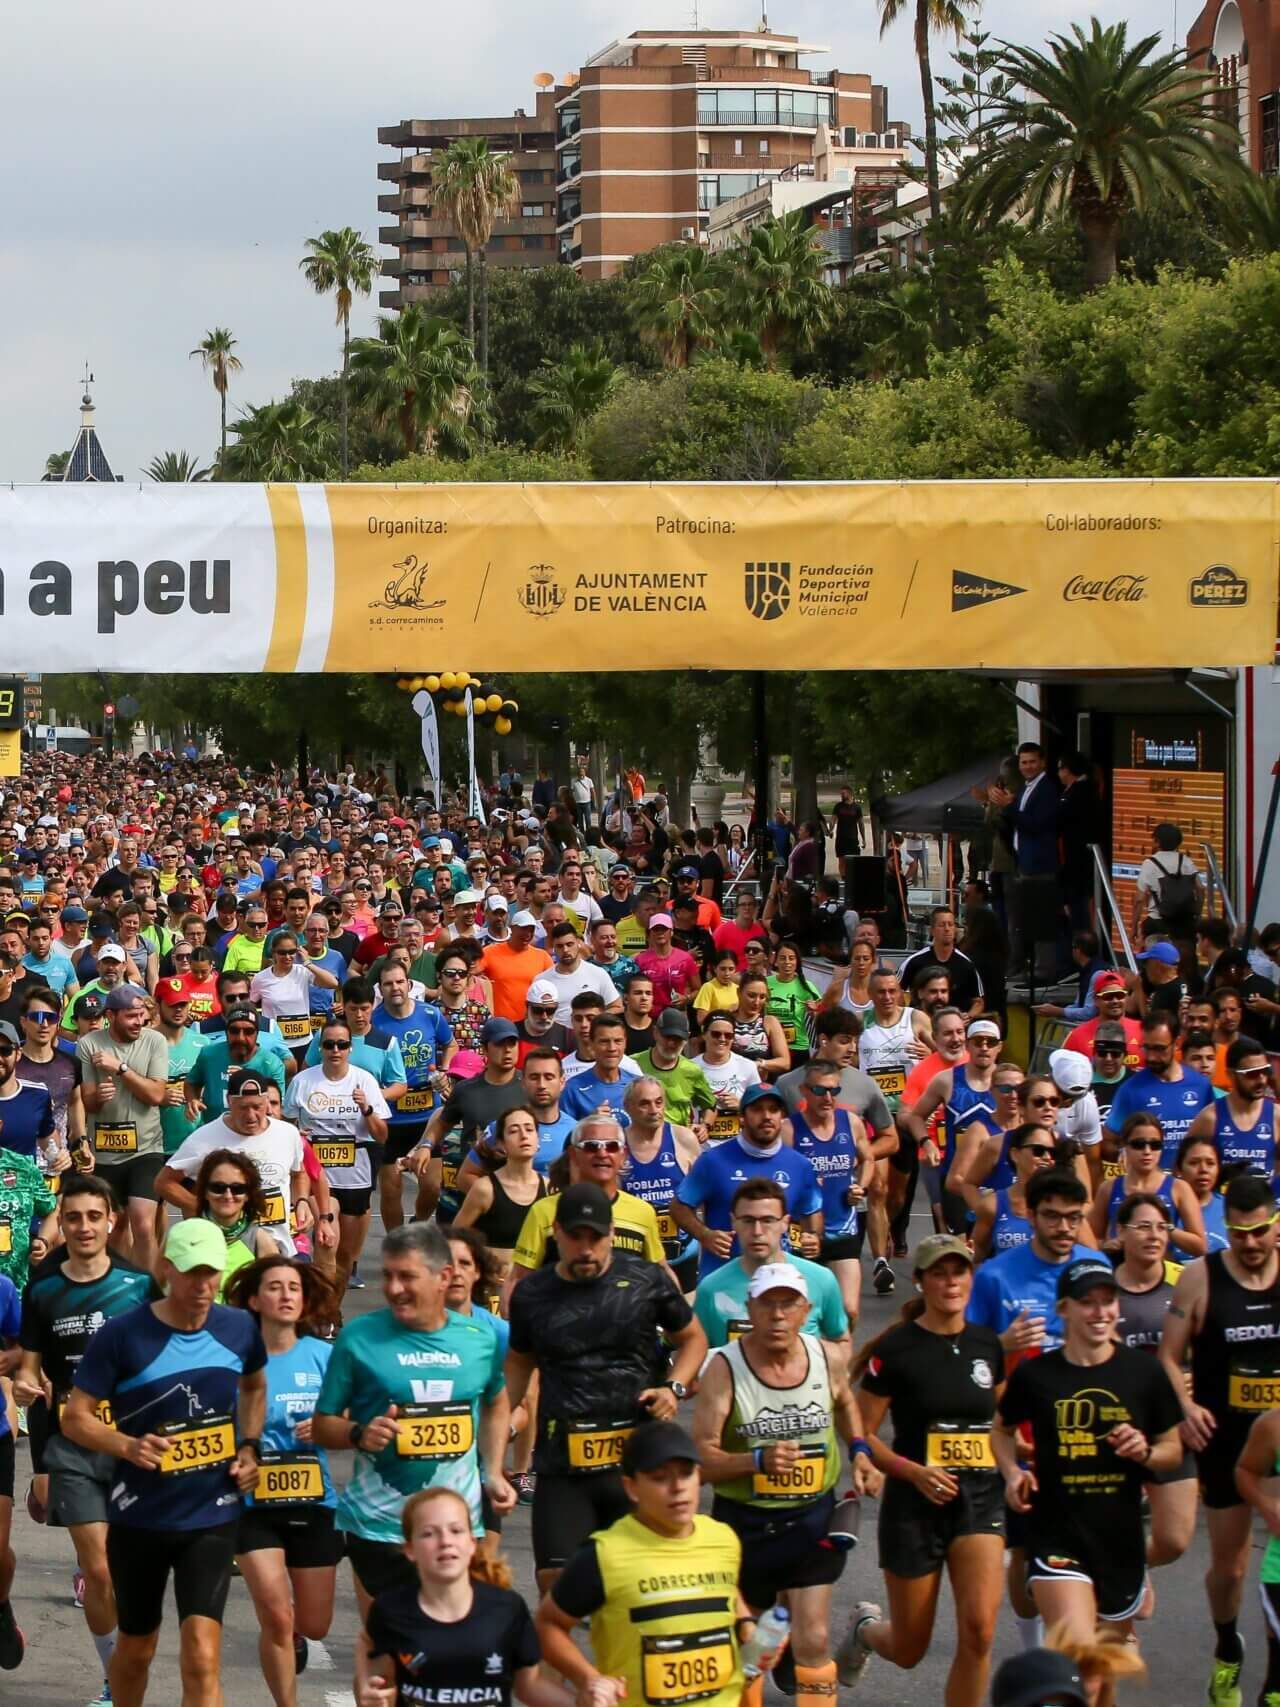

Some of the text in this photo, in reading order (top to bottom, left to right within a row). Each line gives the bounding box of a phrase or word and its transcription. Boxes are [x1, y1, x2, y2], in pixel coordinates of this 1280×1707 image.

[367, 515, 449, 535] Organitza:
[656, 515, 736, 535] Patrocina:
[1046, 513, 1161, 533] Col·laboradors:
[799, 564, 874, 576] Fundación
[575, 573, 708, 589] AJUNTAMENT
[799, 578, 871, 591] Deportiva
[1063, 575, 1151, 602] Coca-Cola
[28, 559, 73, 616] a
[97, 559, 231, 634] peu
[799, 590, 869, 605] Municipal
[1193, 583, 1246, 598] PÉREZ
[574, 592, 707, 612] DE VALÈNCIA
[386, 616, 445, 625] correcaminos
[284, 1023, 304, 1034] 6166
[403, 1094, 427, 1106] 6143
[103, 1134, 129, 1146] 7038
[810, 1154, 850, 1165] OBLATS
[626, 1178, 671, 1191] POBLATS
[635, 1189, 674, 1202] ARÍTIMS
[1225, 1324, 1280, 1342] REDOL
[397, 1352, 461, 1368] VALENCIA
[411, 1423, 460, 1447] 3238
[172, 1433, 224, 1462] 3333
[941, 1439, 983, 1461] 5630
[267, 1470, 311, 1491] 6087
[662, 1657, 718, 1689] 3086
[402, 1683, 502, 1705] VALENCIA
